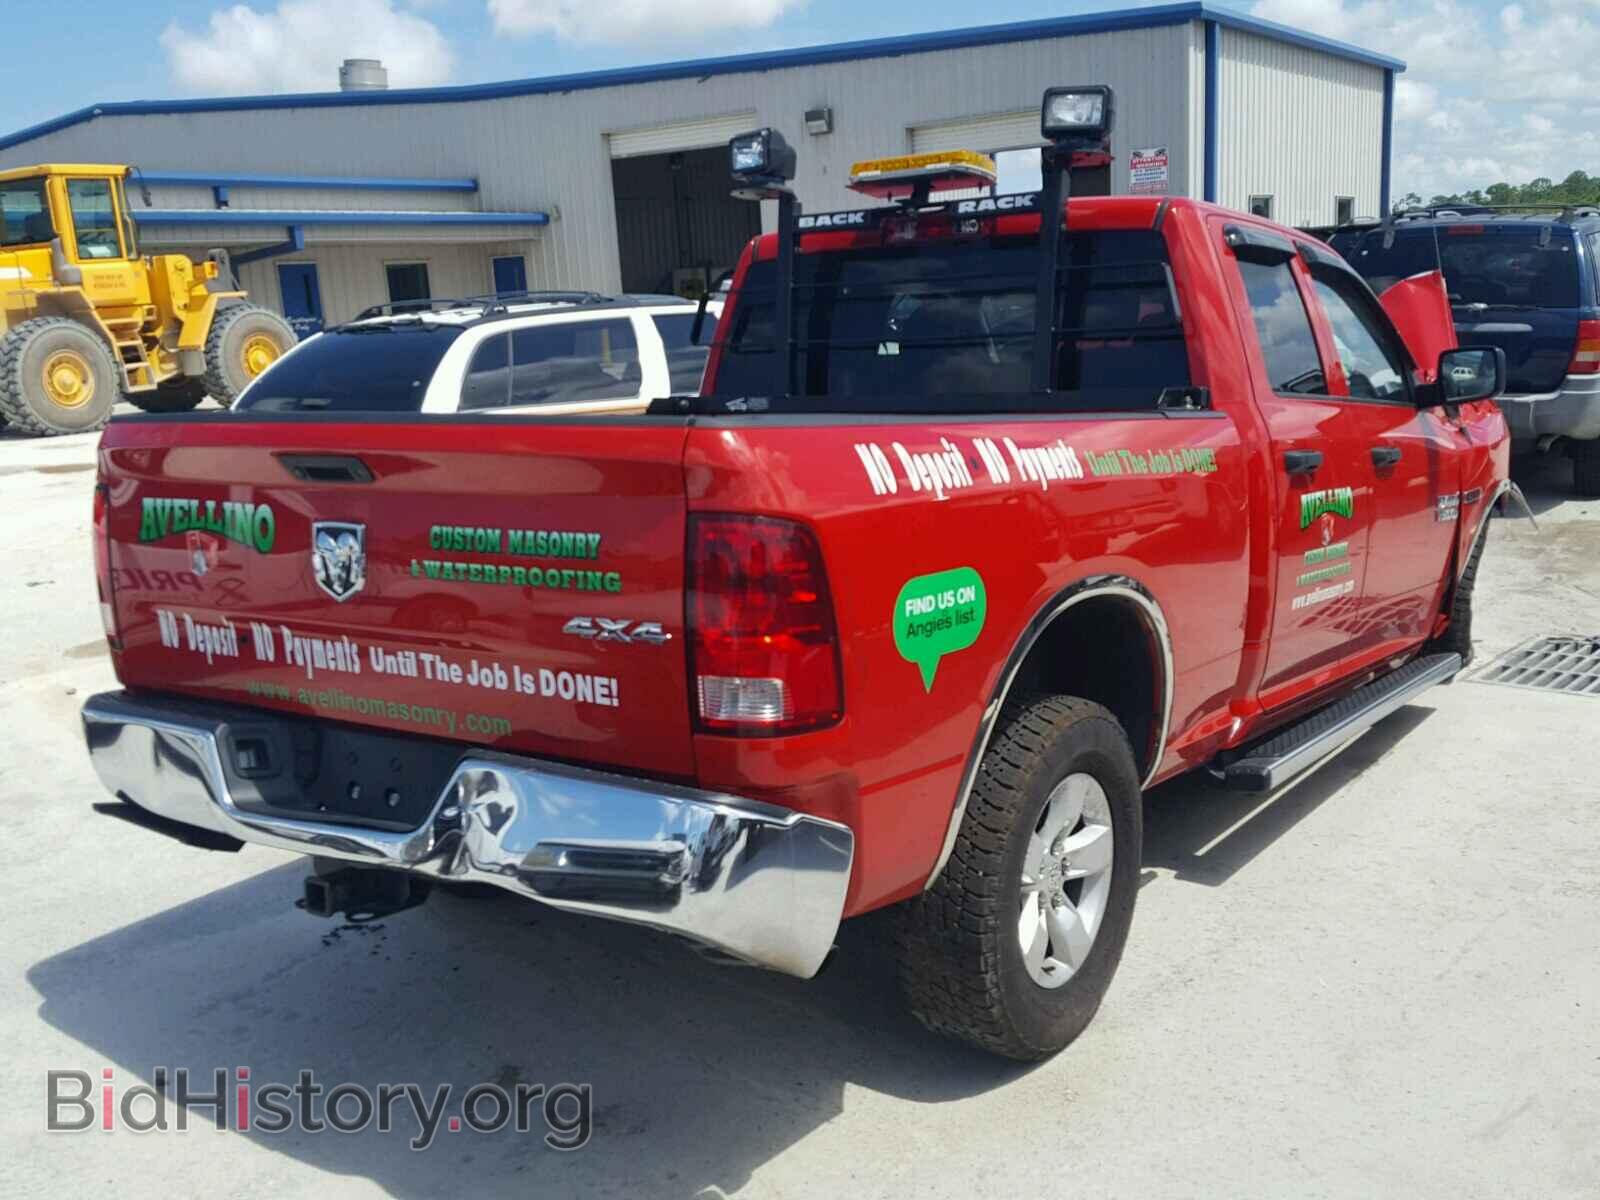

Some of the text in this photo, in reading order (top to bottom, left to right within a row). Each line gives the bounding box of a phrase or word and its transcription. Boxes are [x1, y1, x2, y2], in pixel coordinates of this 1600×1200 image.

[799, 194, 1034, 228] BACK RACK
[855, 442, 897, 495] NO
[892, 437, 973, 501] Deposit
[972, 438, 1010, 484] NO
[1002, 437, 1084, 491] Payments
[139, 496, 276, 554] AVELLINO
[430, 525, 601, 558] CUSTOM MASONRY
[423, 559, 622, 592] WATERPROOFING
[905, 585, 977, 617] FIND US ON
[954, 608, 976, 627] list
[157, 608, 620, 708] NO Deposit NO Payments Until The Job Is DONE!
